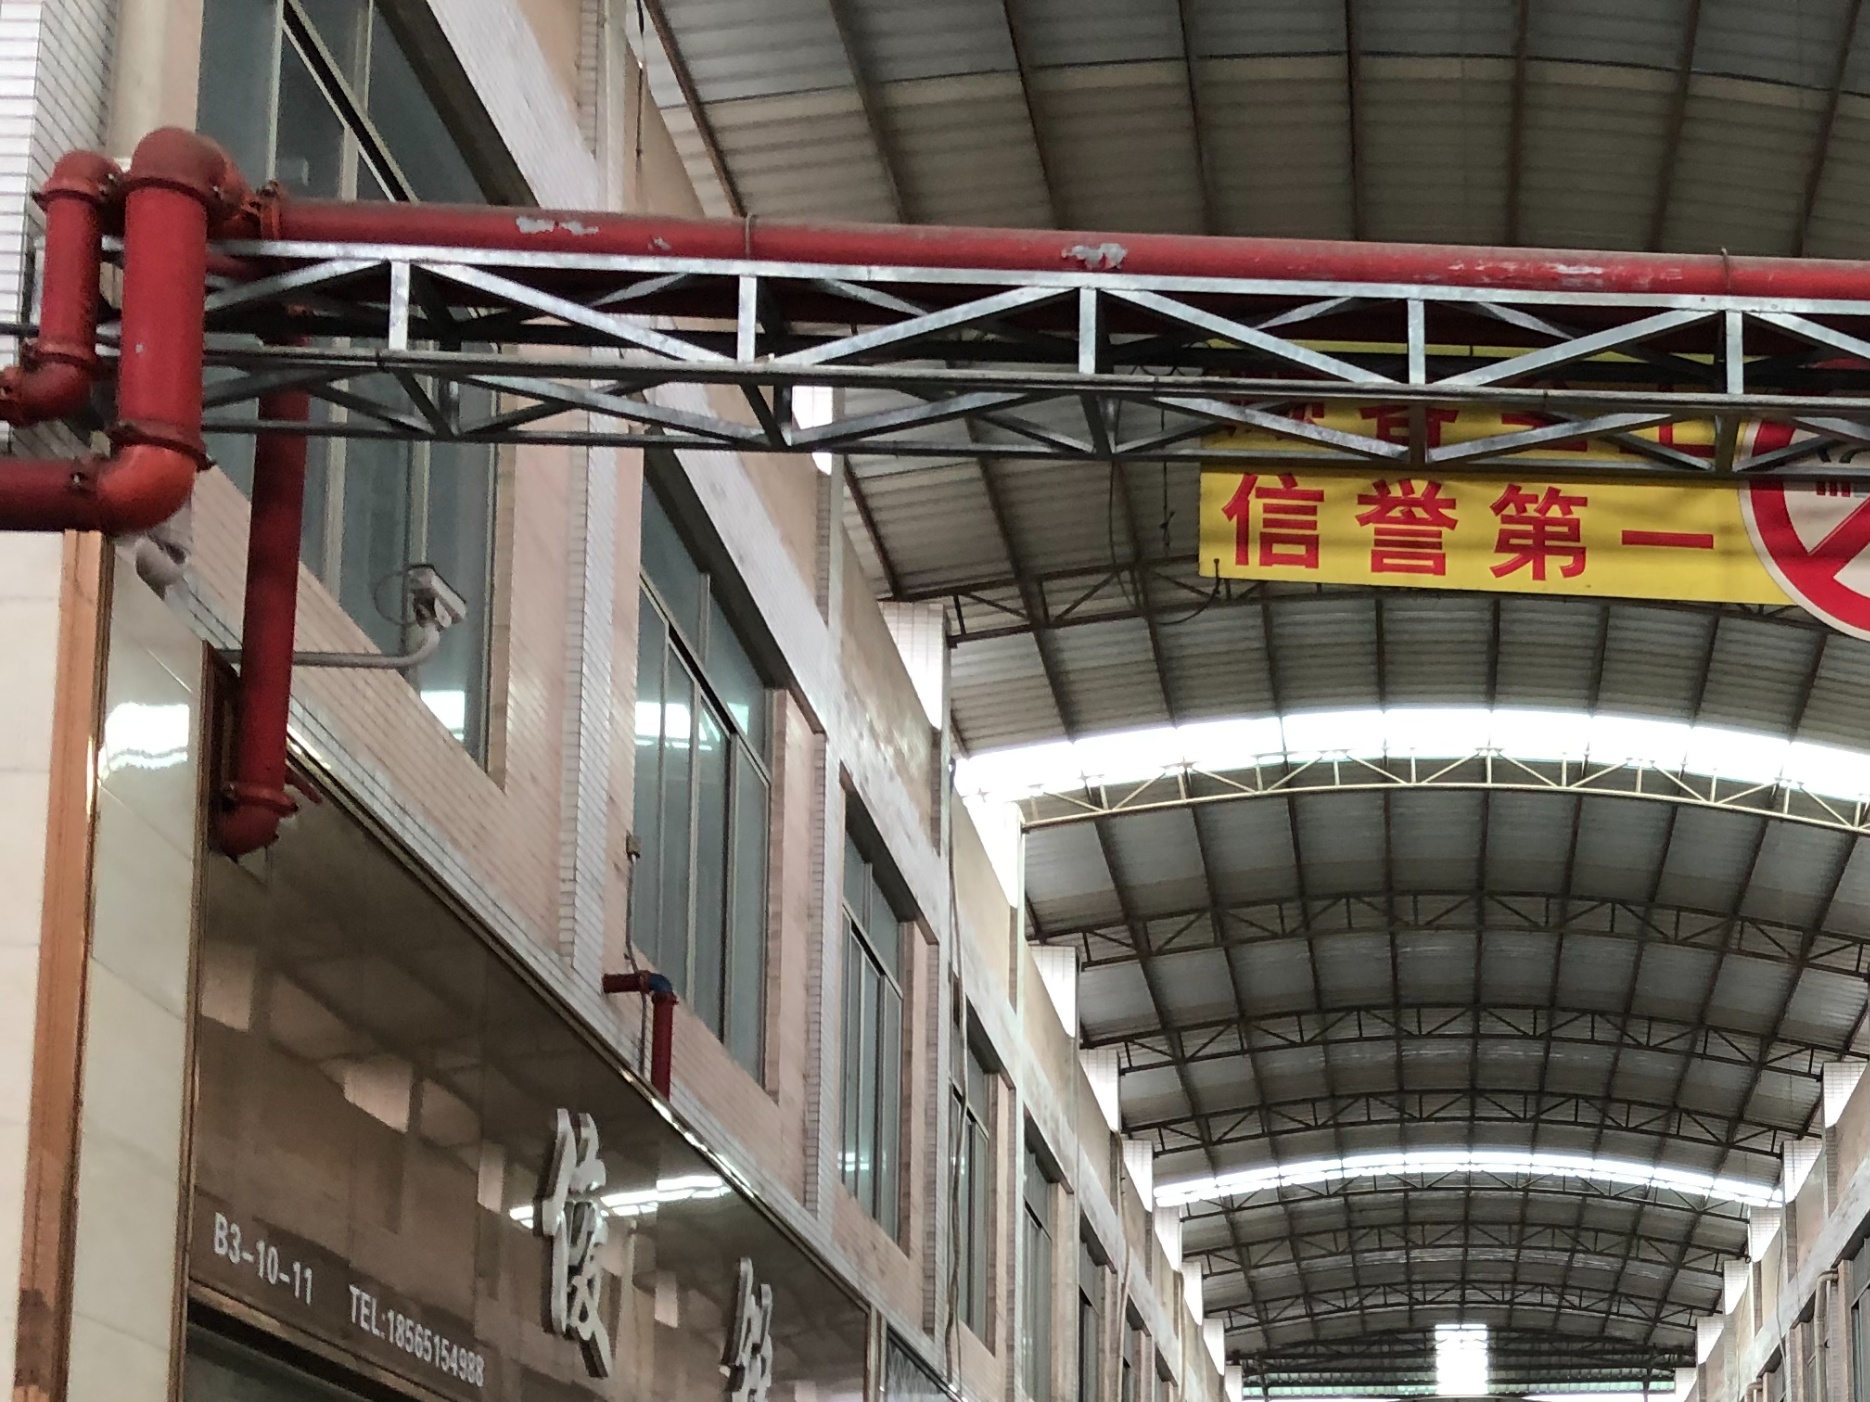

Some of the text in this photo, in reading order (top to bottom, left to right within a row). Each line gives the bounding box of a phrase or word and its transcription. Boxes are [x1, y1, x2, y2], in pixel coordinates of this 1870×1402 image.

[1222, 472, 1714, 581] 信誉第一
[213, 1211, 313, 1306] B3-10-11
